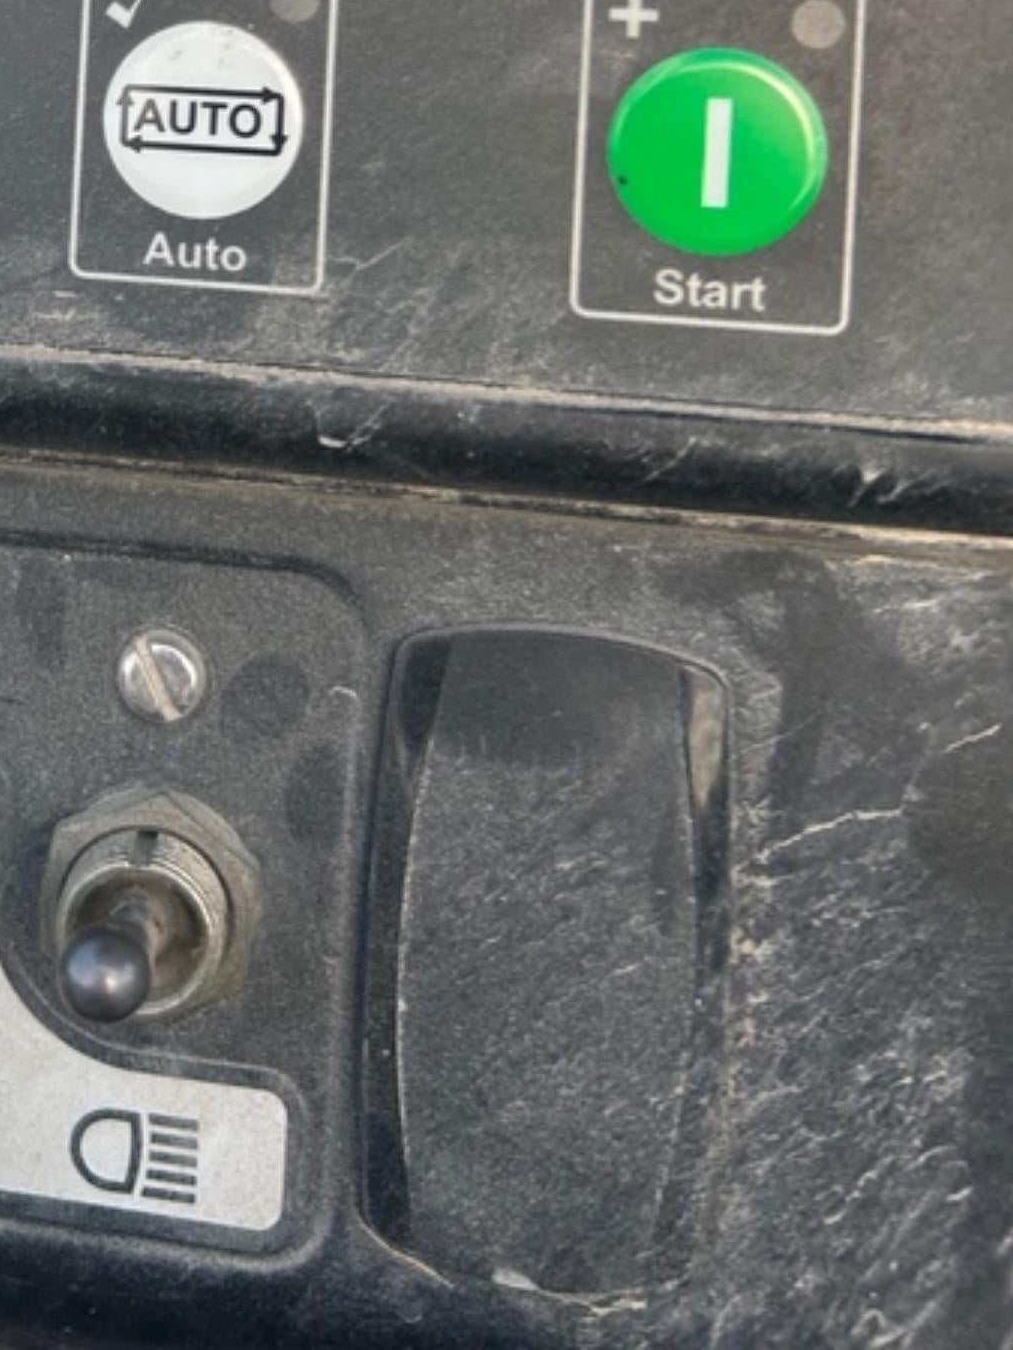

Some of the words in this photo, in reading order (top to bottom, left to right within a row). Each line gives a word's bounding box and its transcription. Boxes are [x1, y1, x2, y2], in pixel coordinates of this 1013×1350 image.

[133, 99, 262, 139] AUTO
[143, 231, 248, 273] Auto
[653, 267, 766, 312] Start
